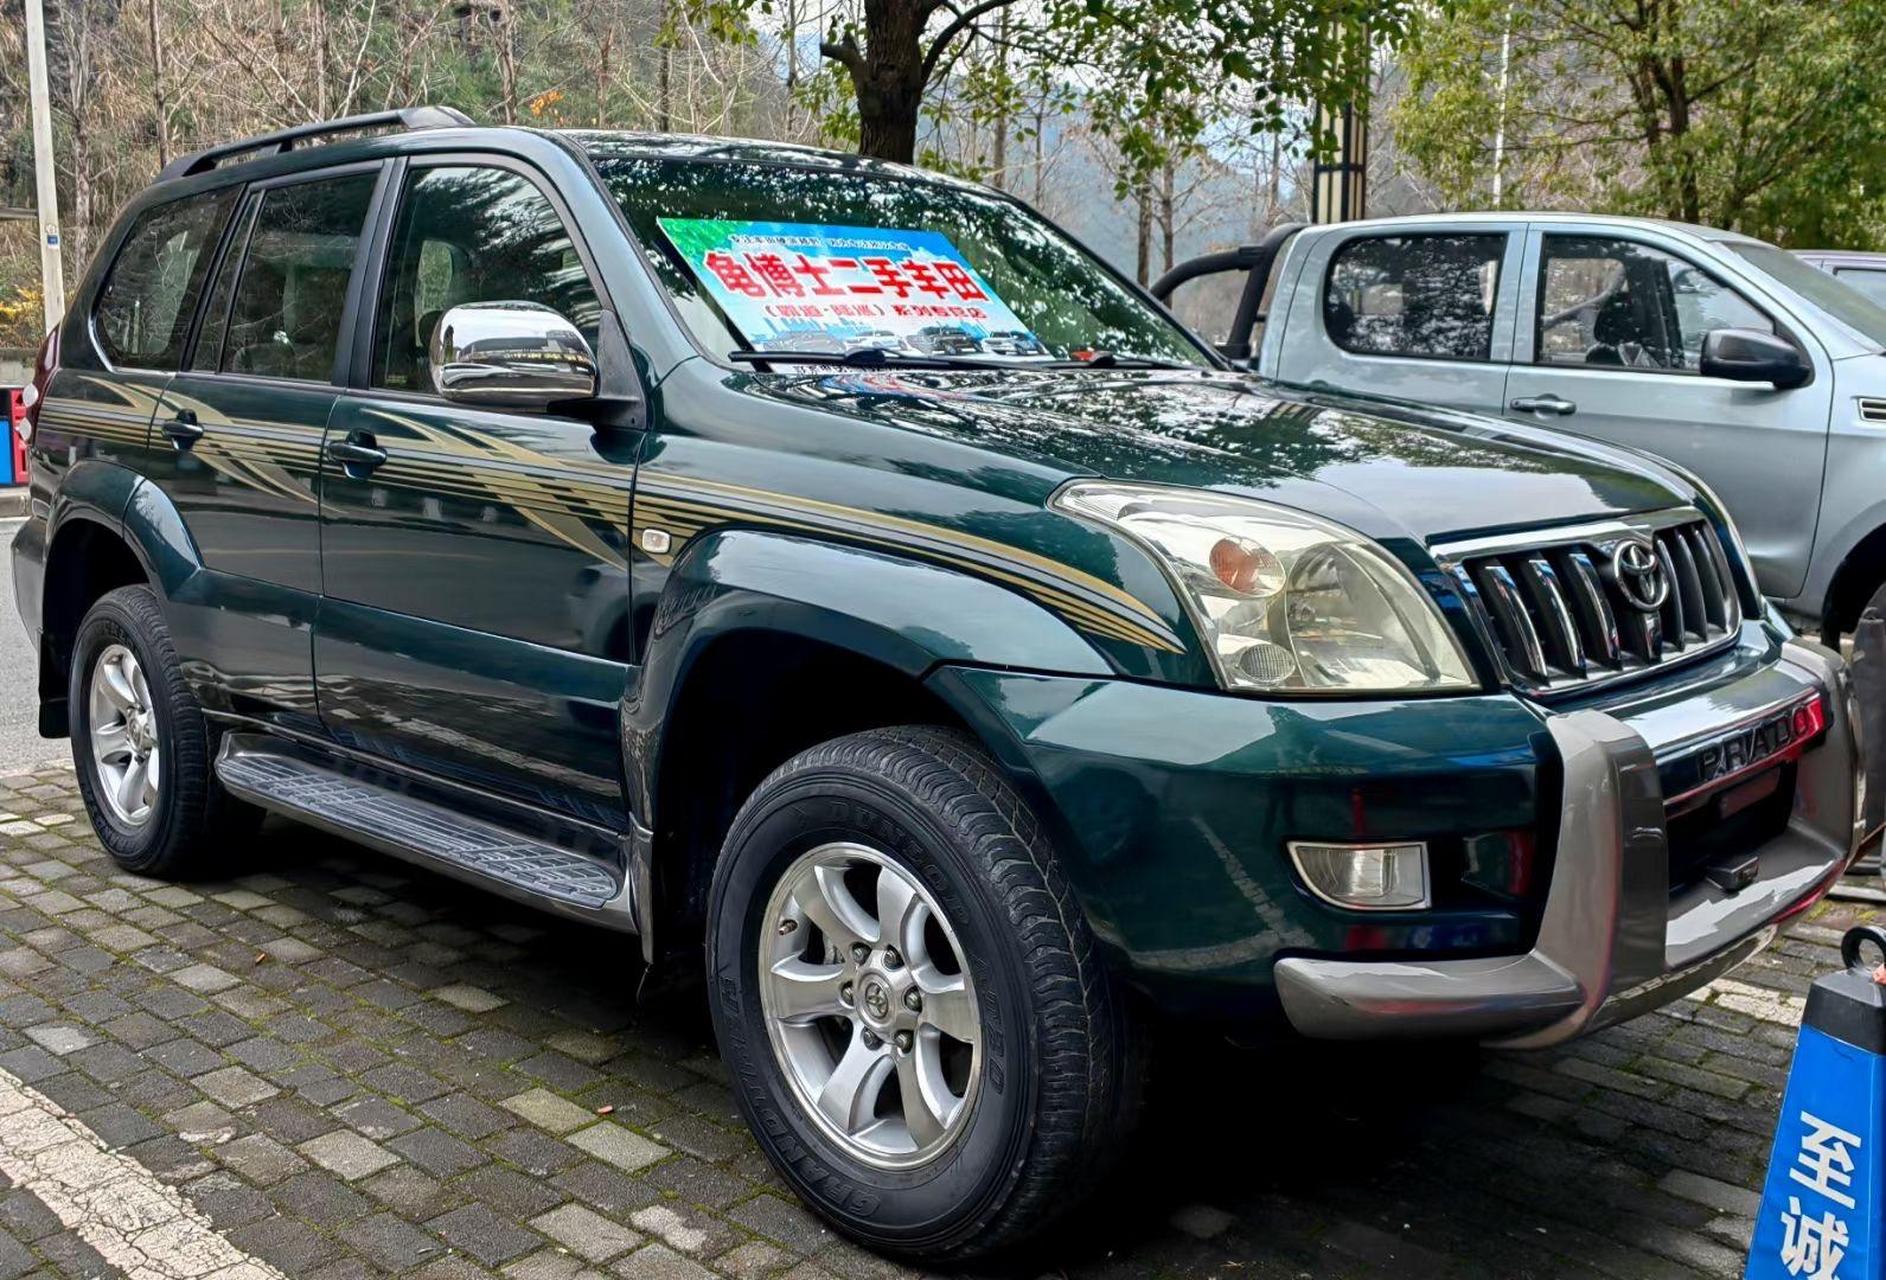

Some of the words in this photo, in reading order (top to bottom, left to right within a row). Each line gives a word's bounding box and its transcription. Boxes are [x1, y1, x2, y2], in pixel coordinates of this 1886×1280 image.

[705, 252, 988, 301] 龟博士二手丰田
[1698, 705, 1809, 782] PRADO
[1781, 1111, 1861, 1280] 至诚
